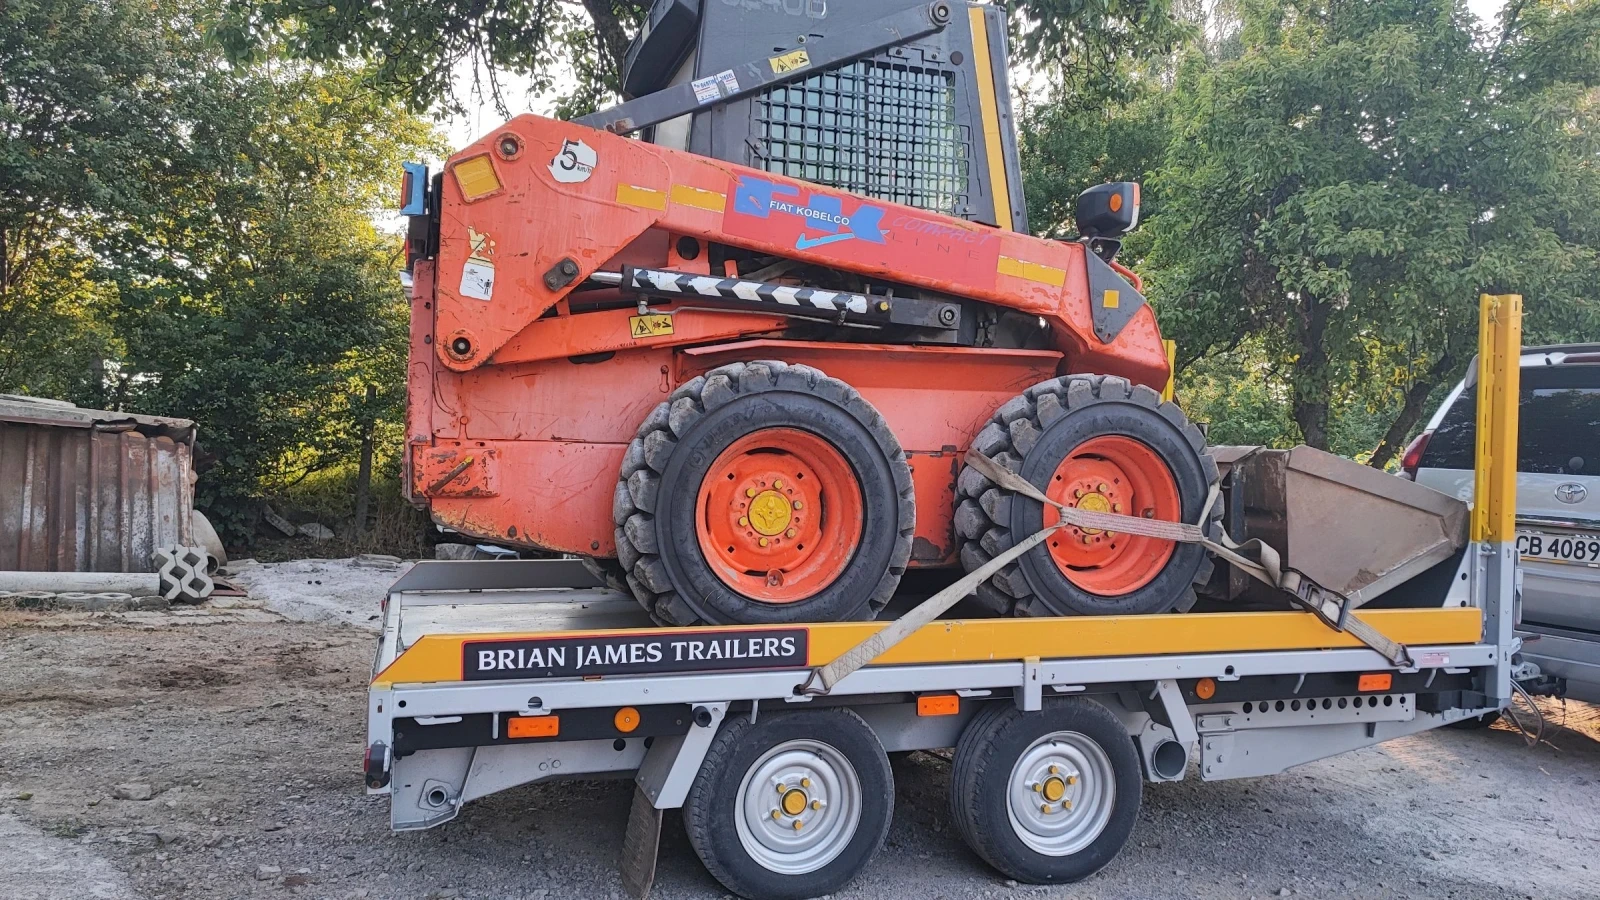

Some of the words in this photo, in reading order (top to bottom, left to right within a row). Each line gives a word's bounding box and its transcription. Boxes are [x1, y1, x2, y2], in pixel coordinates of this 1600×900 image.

[560, 139, 578, 171] 5
[769, 199, 794, 213] FIAT
[796, 205, 850, 226] KOBELCO
[893, 215, 993, 246] COMPACT
[892, 232, 980, 260] LINE
[1515, 535, 1543, 556] CB
[1547, 538, 1600, 562] 4089
[477, 647, 566, 672] BRIAN
[575, 642, 663, 670] JAMES
[671, 637, 796, 662] TRAILERS
